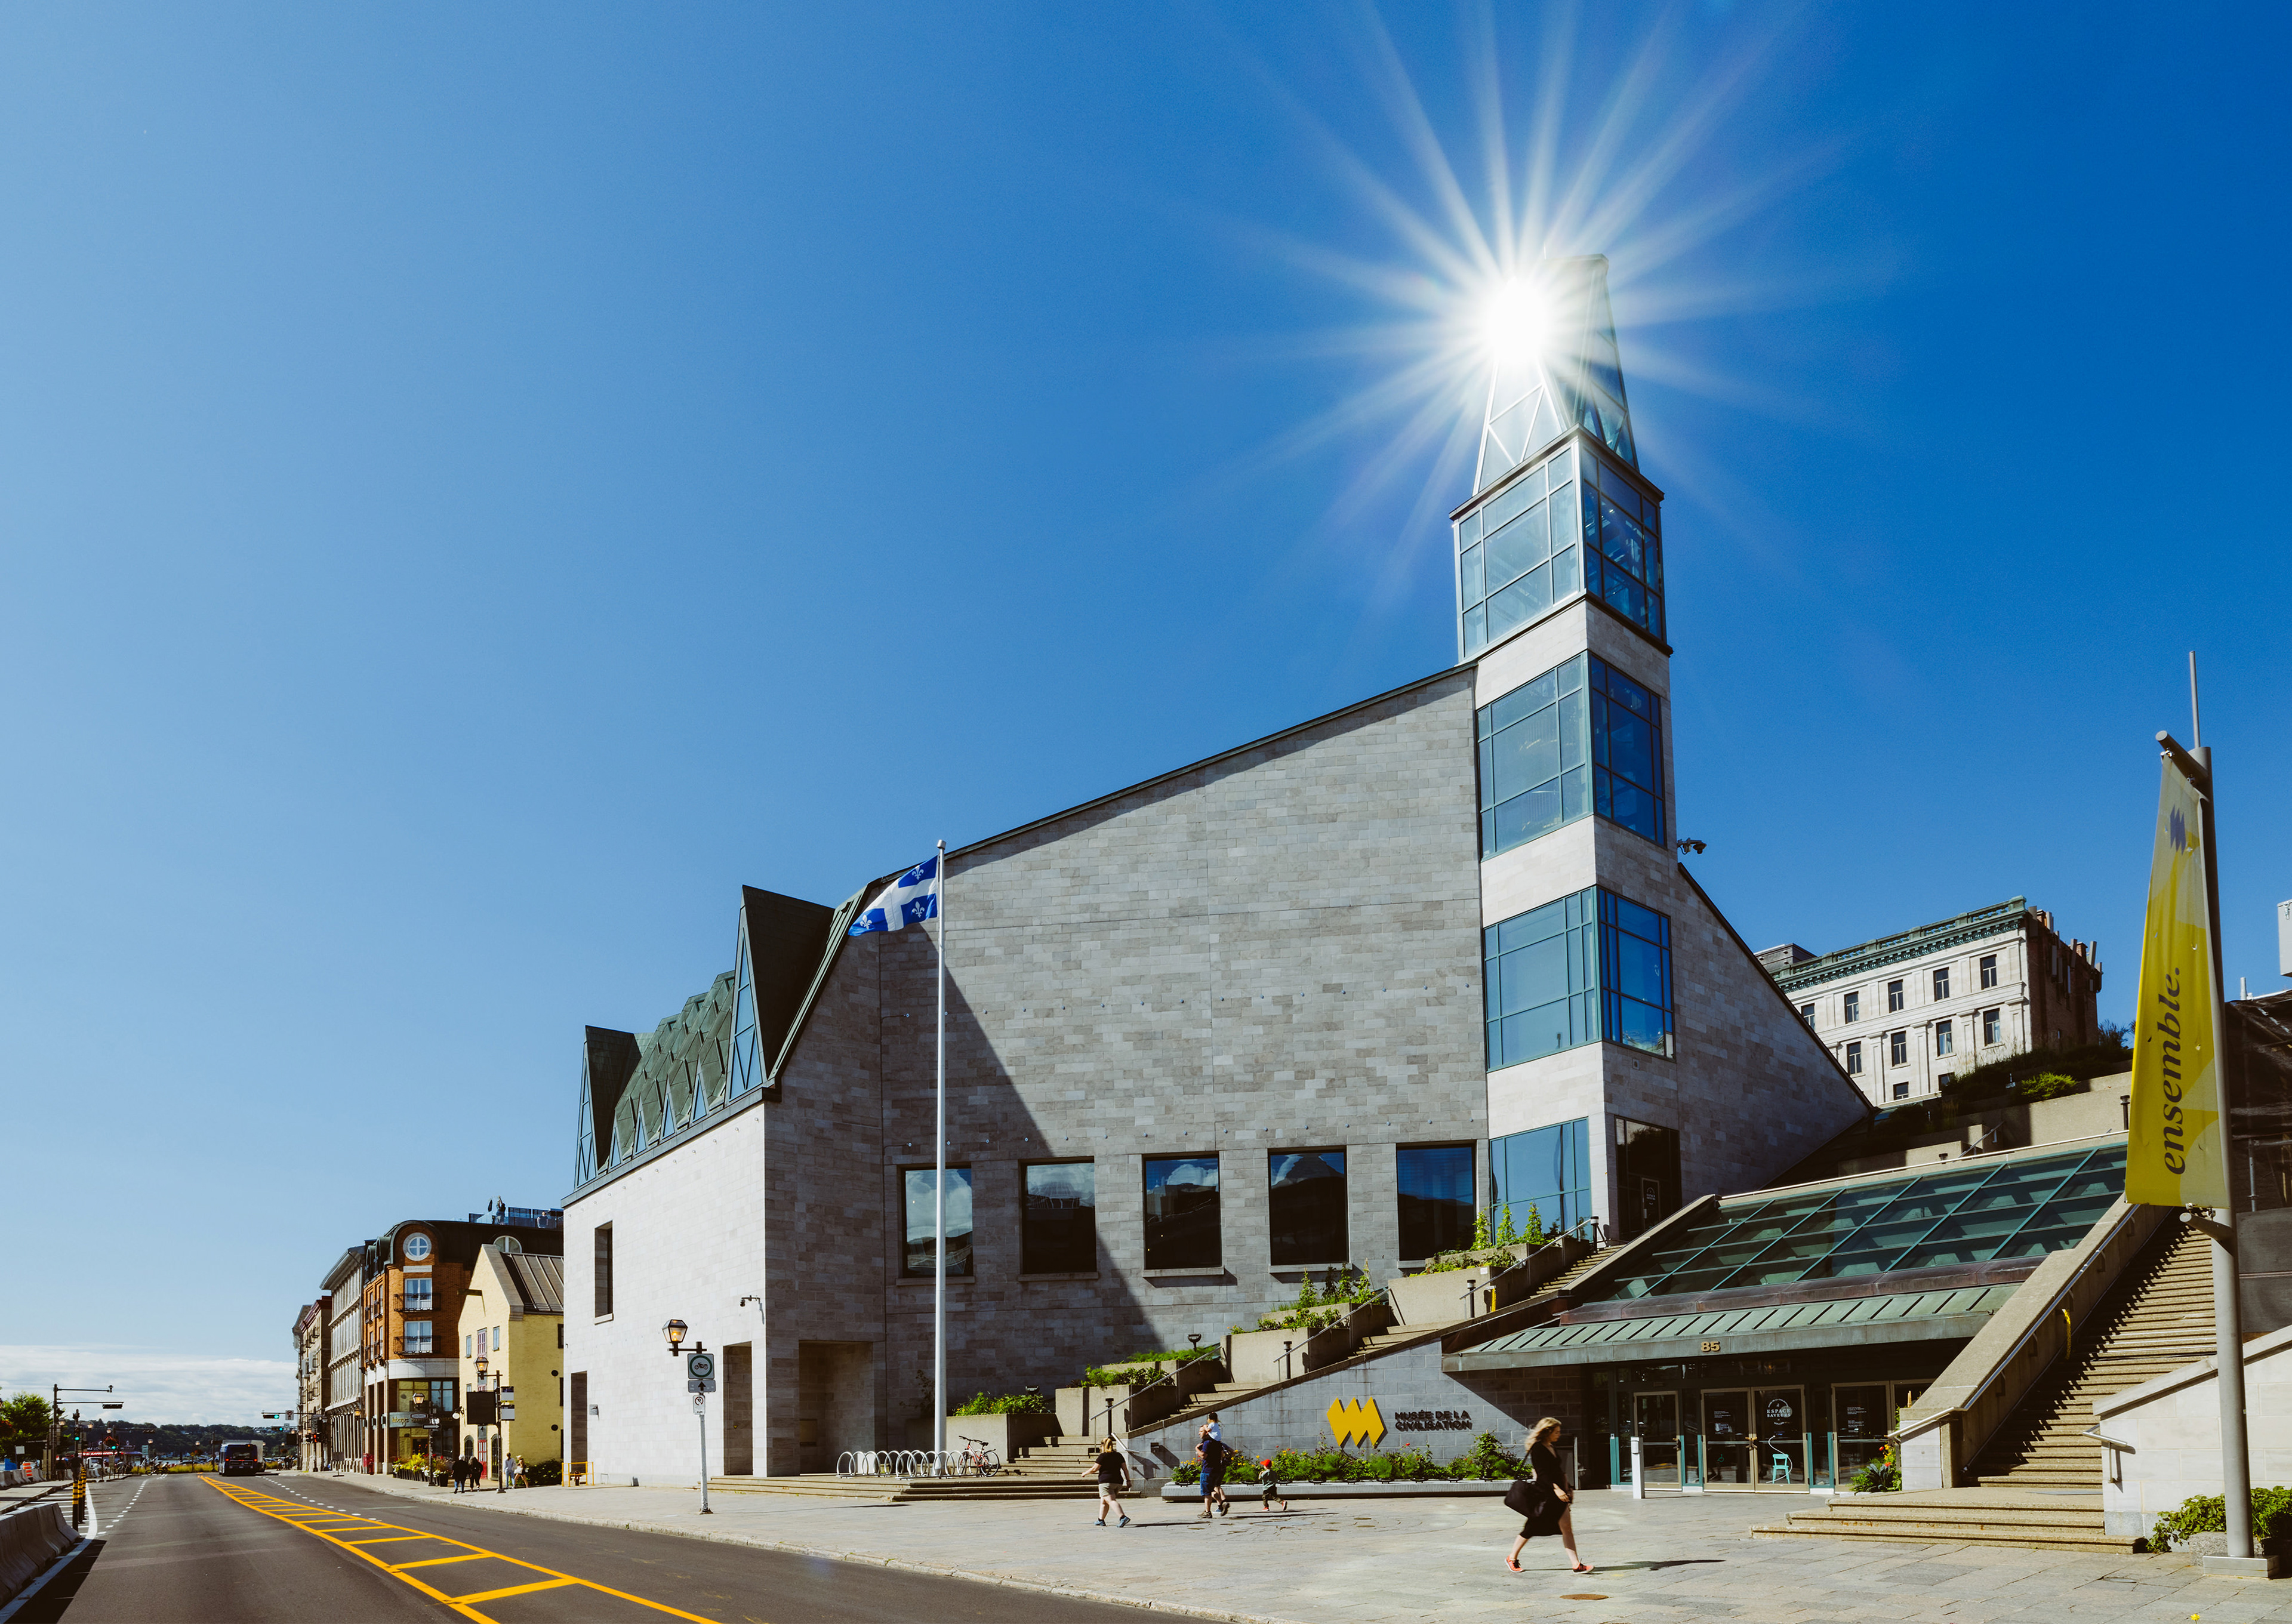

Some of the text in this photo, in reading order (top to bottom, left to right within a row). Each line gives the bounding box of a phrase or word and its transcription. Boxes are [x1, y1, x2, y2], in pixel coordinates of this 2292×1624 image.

[2157, 967, 2186, 1175] ensemble.
[1700, 1341, 1720, 1352] 85
[1394, 1409, 1471, 1420] MUSÉE DE LA
[1395, 1420, 1472, 1432] CIVILISATION
